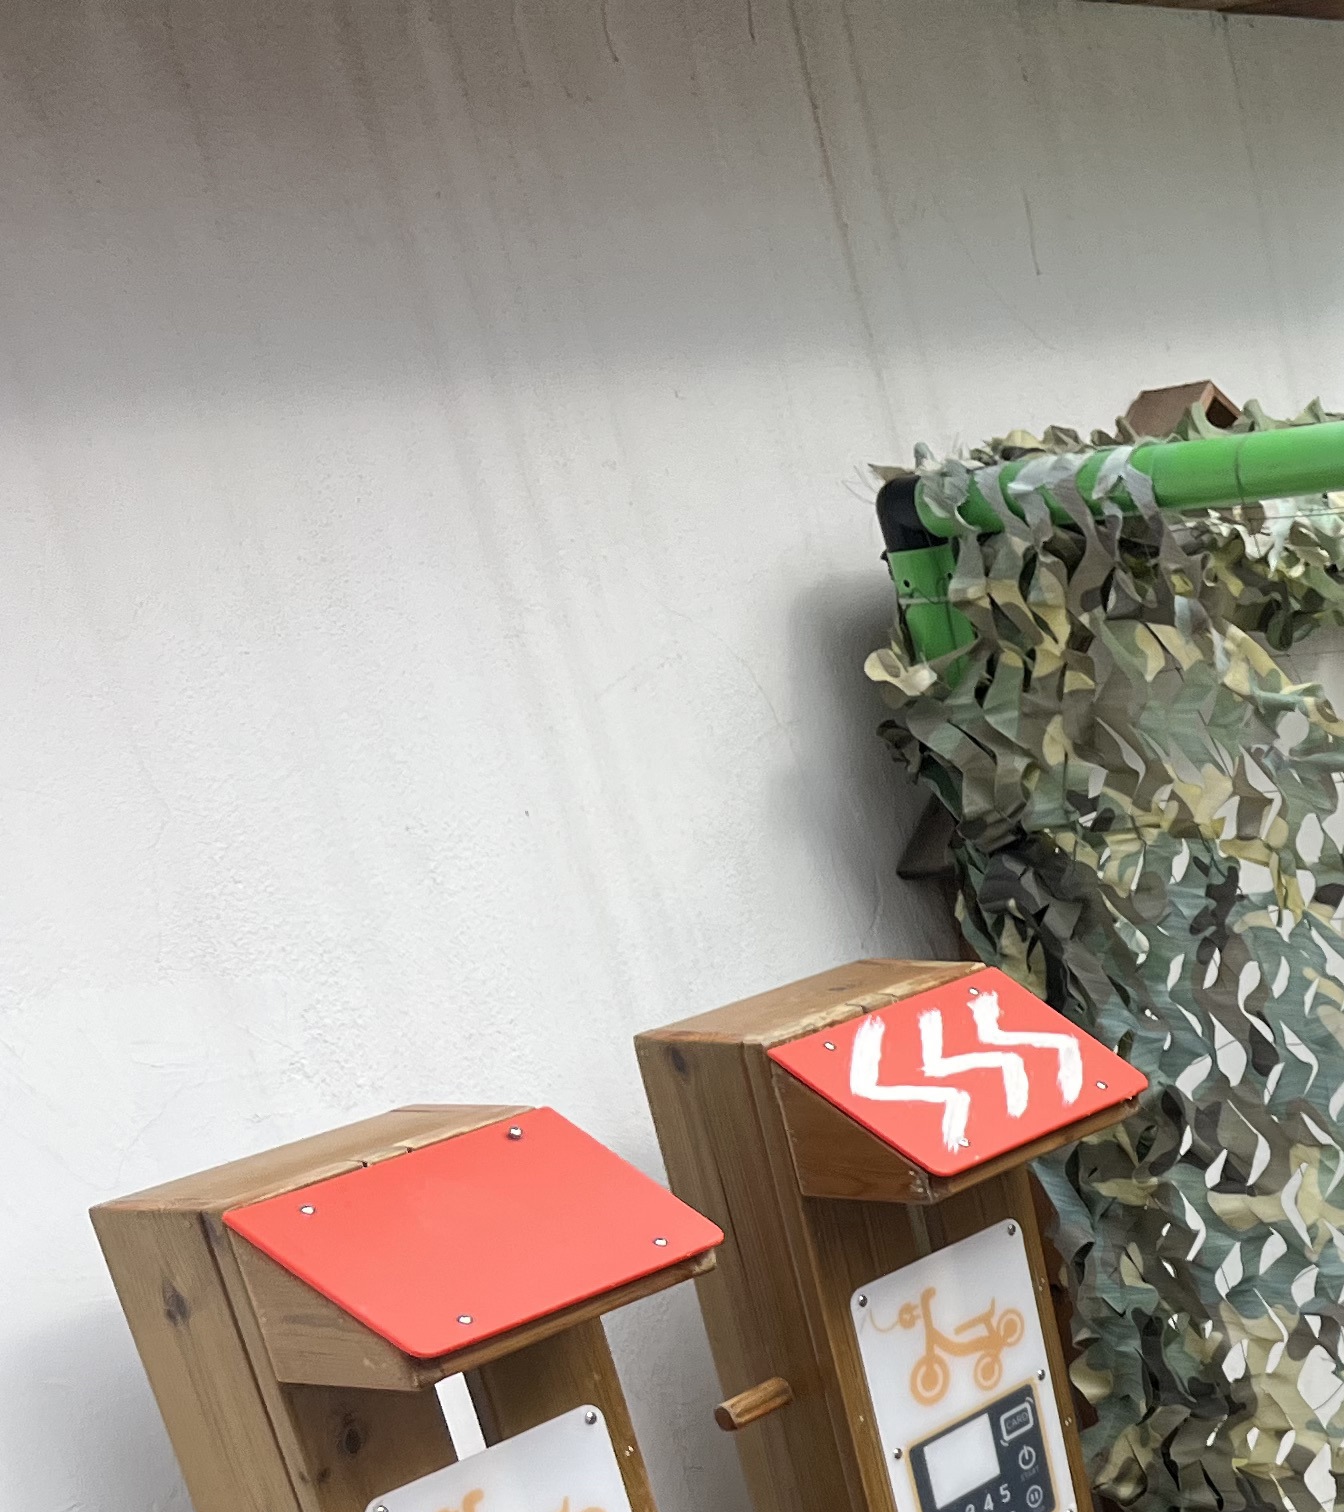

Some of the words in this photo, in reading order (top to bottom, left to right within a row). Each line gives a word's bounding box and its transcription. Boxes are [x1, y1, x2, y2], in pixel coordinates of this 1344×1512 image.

[1005, 1412, 1029, 1430] CARD
[984, 1493, 994, 1511] 4
[999, 1483, 1011, 1503] 5
